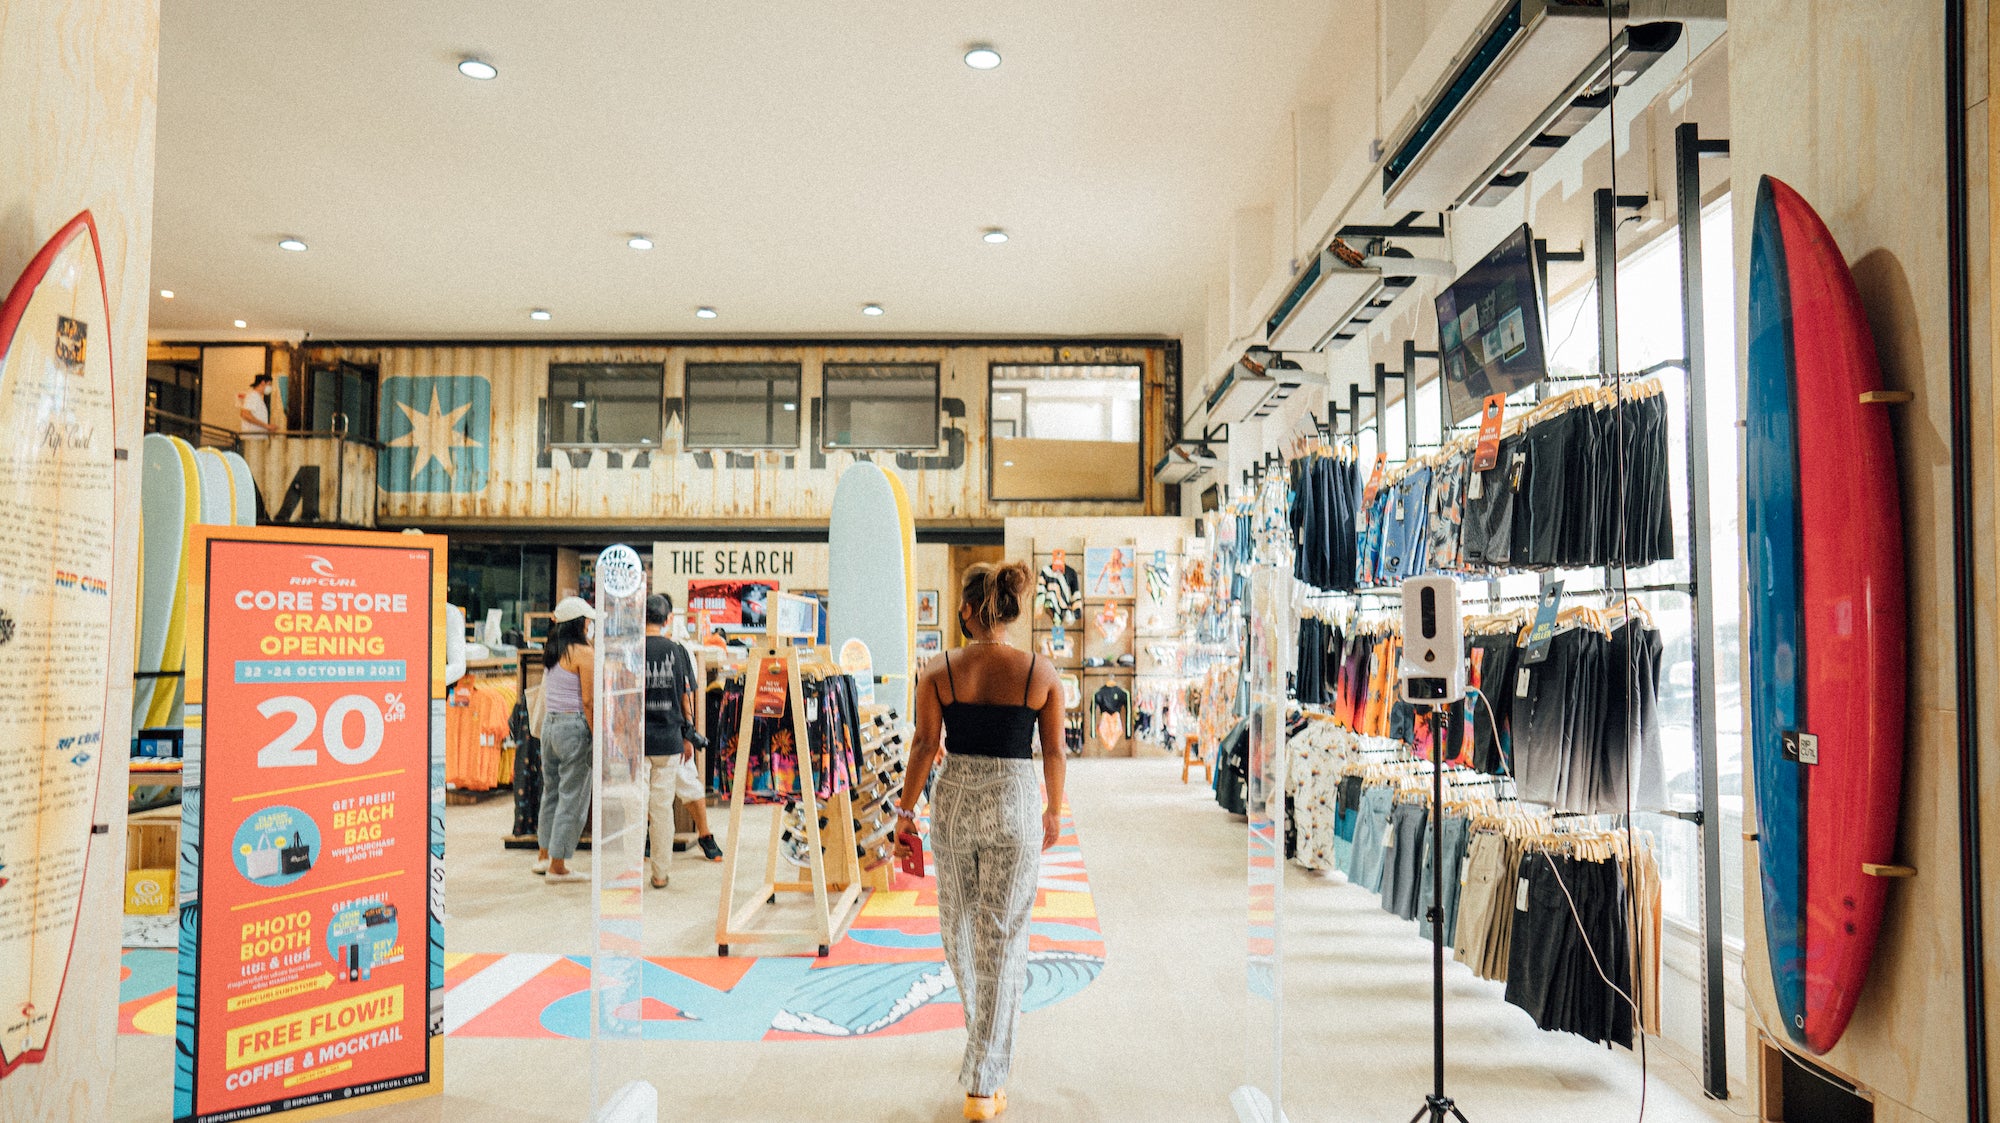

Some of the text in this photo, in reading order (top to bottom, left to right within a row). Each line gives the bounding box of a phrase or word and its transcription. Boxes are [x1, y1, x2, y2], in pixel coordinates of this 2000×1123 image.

[671, 551, 793, 574] THE SEARCH
[56, 569, 78, 588] RIP
[81, 575, 107, 596] CURL
[289, 576, 357, 587] RIP CURL
[234, 590, 408, 613] CORE STORE
[274, 613, 373, 633] GRAND
[260, 635, 385, 656] OPENING
[244, 666, 262, 678] 22
[297, 665, 365, 677] OCTOBER
[370, 665, 401, 676] 2021
[384, 712, 406, 722] OFF
[257, 694, 385, 768] 20
[332, 790, 395, 812] GET FREE!!
[333, 803, 394, 830] BEACH
[344, 823, 382, 845] BAG
[331, 837, 395, 858] WHEN PURCHASE
[331, 900, 352, 913] GET
[241, 910, 311, 942] PHOTO
[240, 928, 311, 962] BOOTH
[373, 944, 404, 961] CHAIN
[238, 995, 394, 1058] FREE FLOW!!
[225, 1056, 295, 1091] COFFEE
[302, 1051, 314, 1069] &
[319, 1026, 403, 1064] MOCKTAIL
[353, 1075, 423, 1095] WWW.RIPCURL.CO.TH
[207, 1104, 272, 1122] RIPCURLTHAILAND
